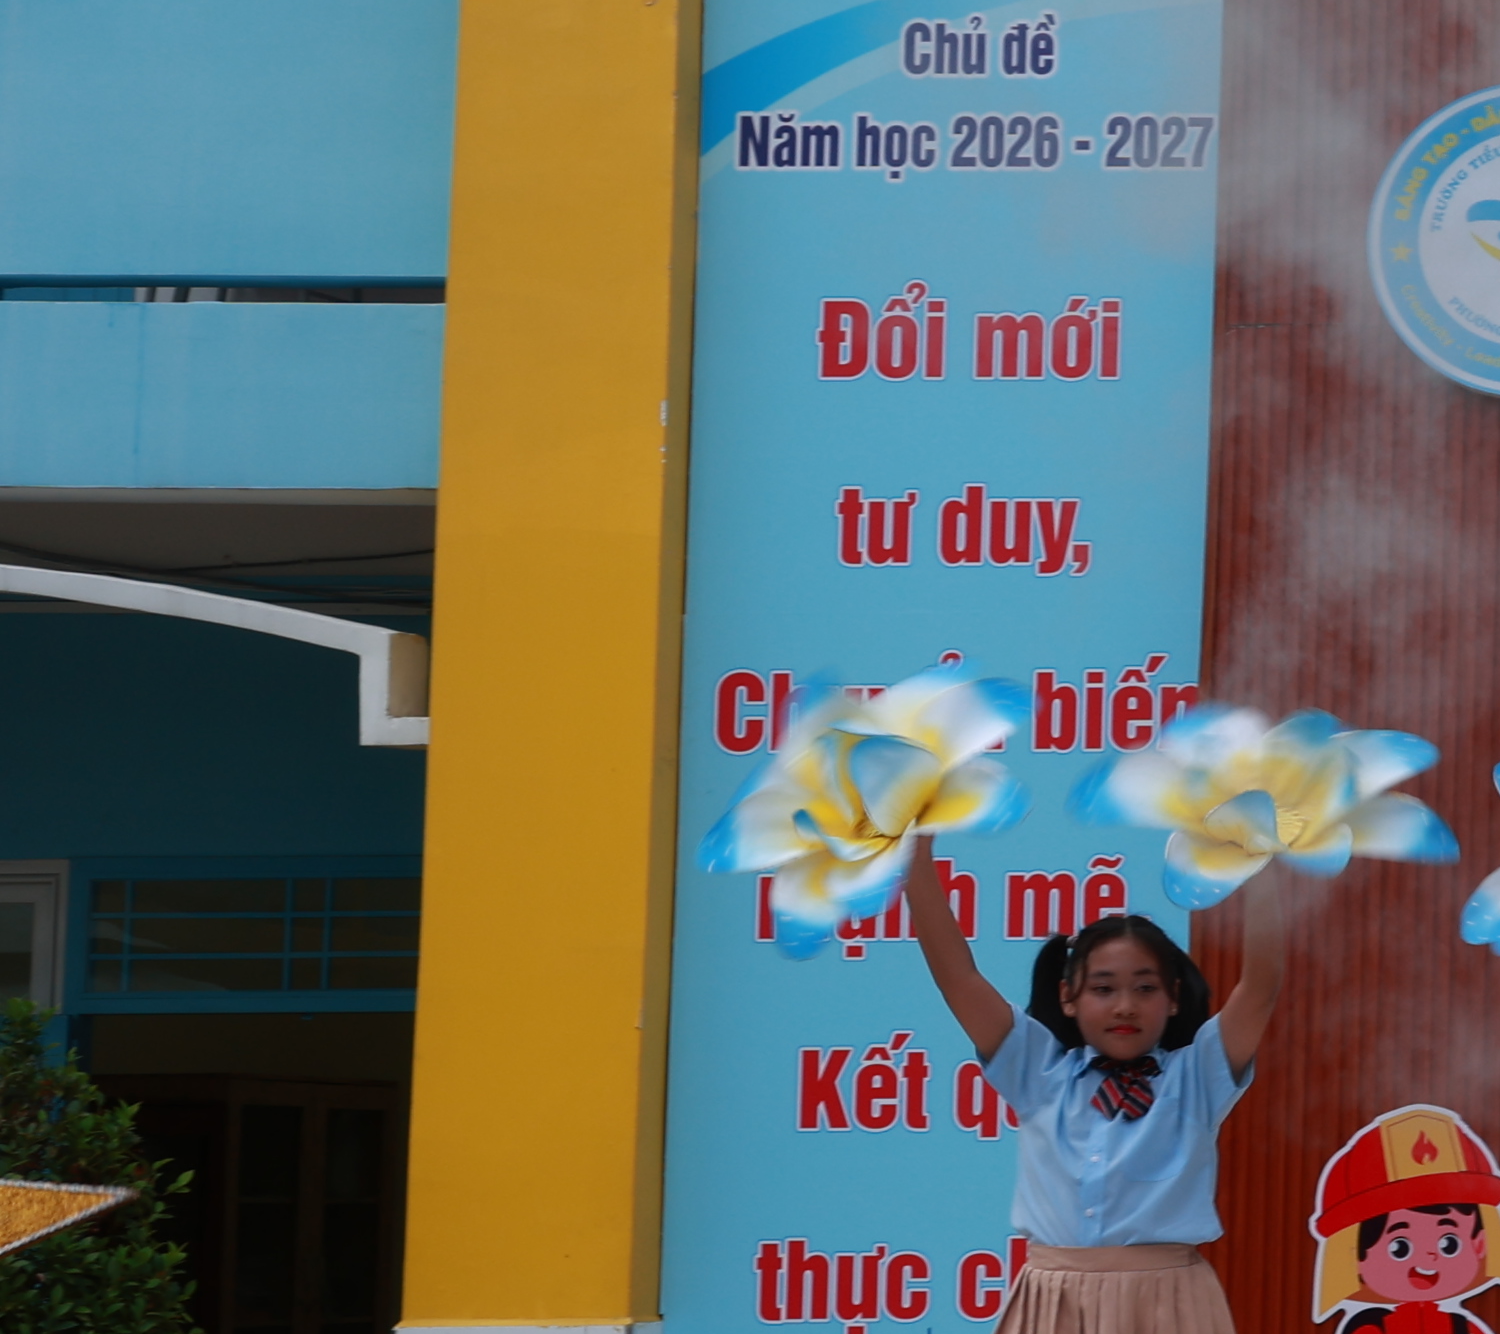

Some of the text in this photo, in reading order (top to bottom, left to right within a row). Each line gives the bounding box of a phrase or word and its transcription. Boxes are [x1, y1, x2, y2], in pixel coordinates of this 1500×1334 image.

[903, 13, 1057, 76] Chủ đề
[738, 113, 1215, 180] Năm học 2026 2027
[817, 280, 1121, 381] Đổi mới
[836, 483, 1092, 577] tư duy,
[797, 1031, 931, 1133] Kết
